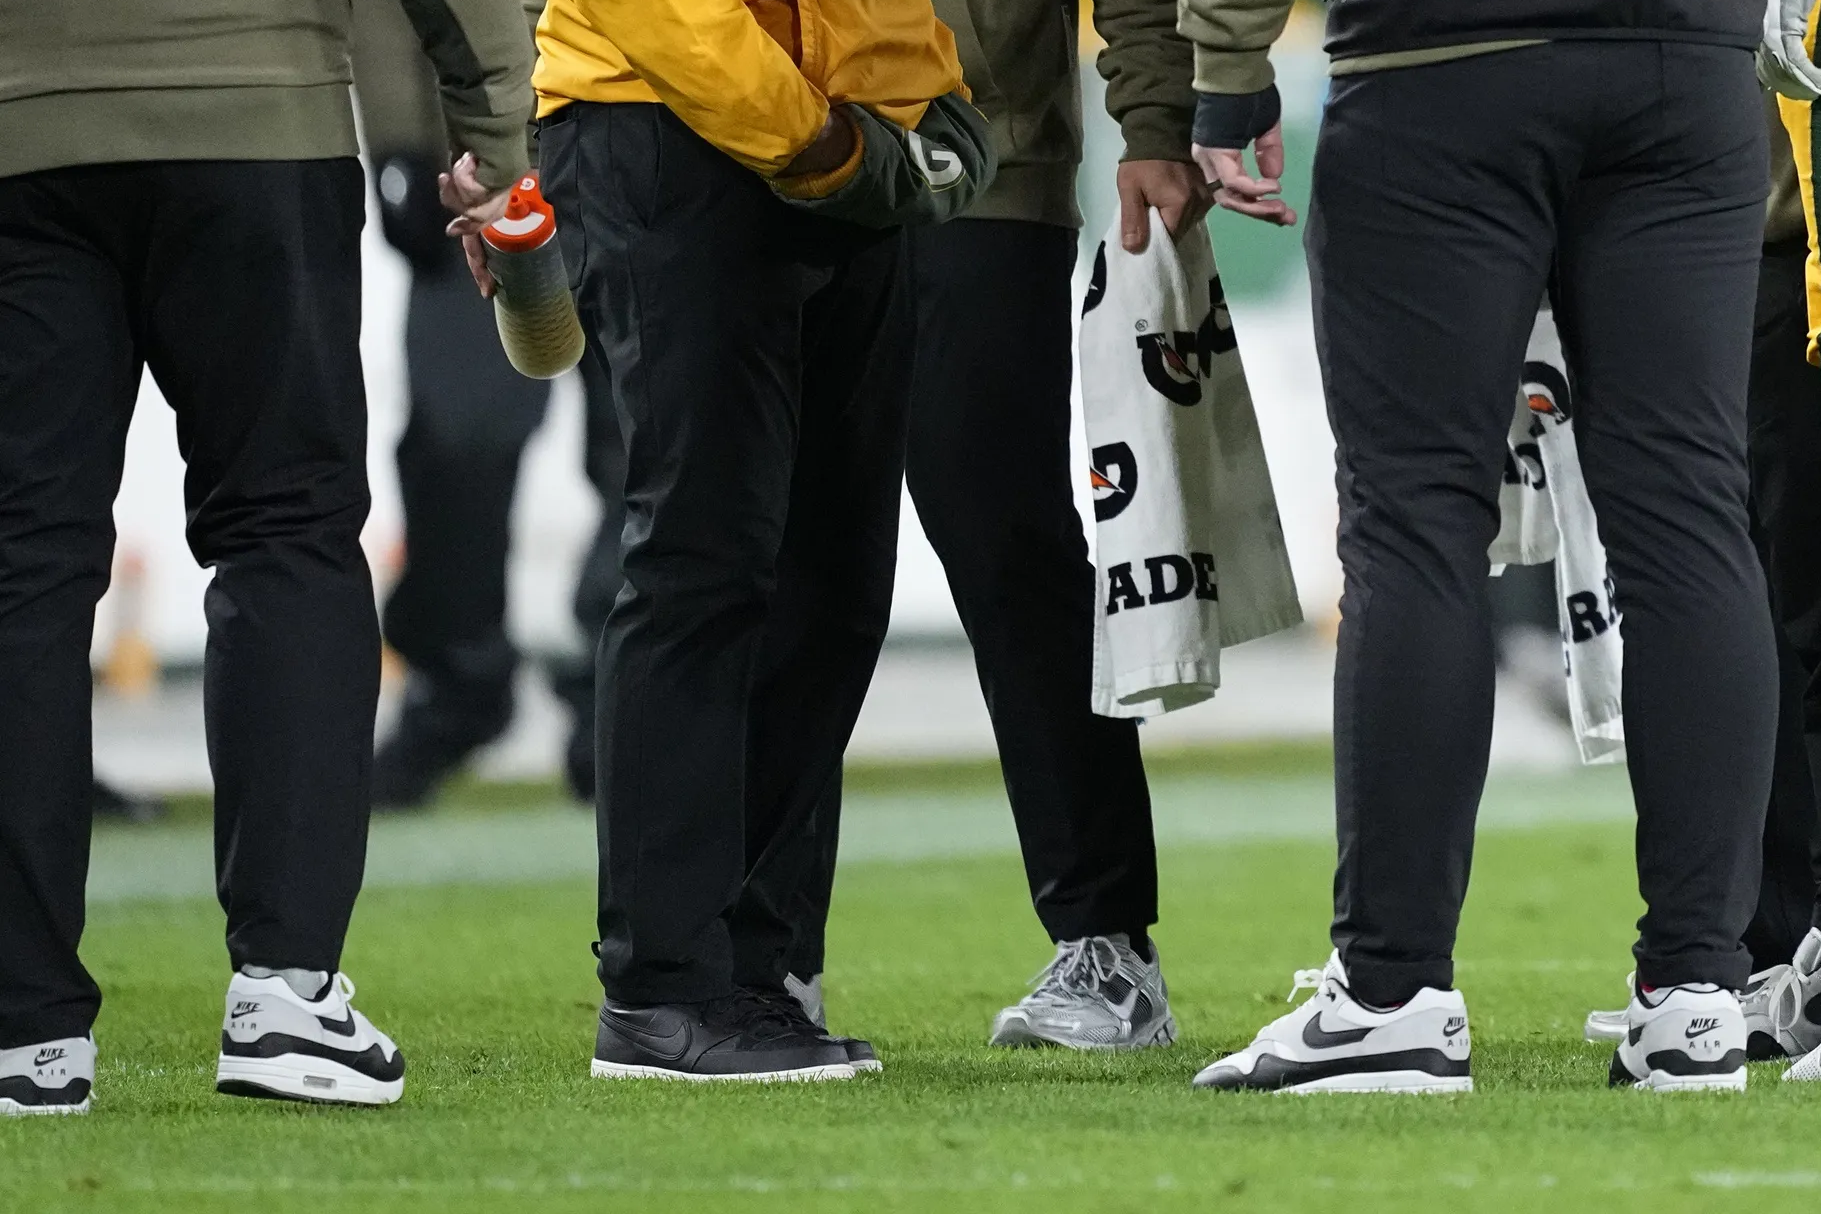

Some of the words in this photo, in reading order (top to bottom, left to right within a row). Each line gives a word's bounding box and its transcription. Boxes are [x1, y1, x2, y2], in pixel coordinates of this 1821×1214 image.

[1107, 552, 1219, 616] ADE
[235, 1001, 261, 1013] NIKE
[1690, 1018, 1720, 1029] NIKE
[1688, 1039, 1721, 1049] AIR
[37, 1047, 67, 1059] NIKE
[37, 1068, 67, 1077] AIR
